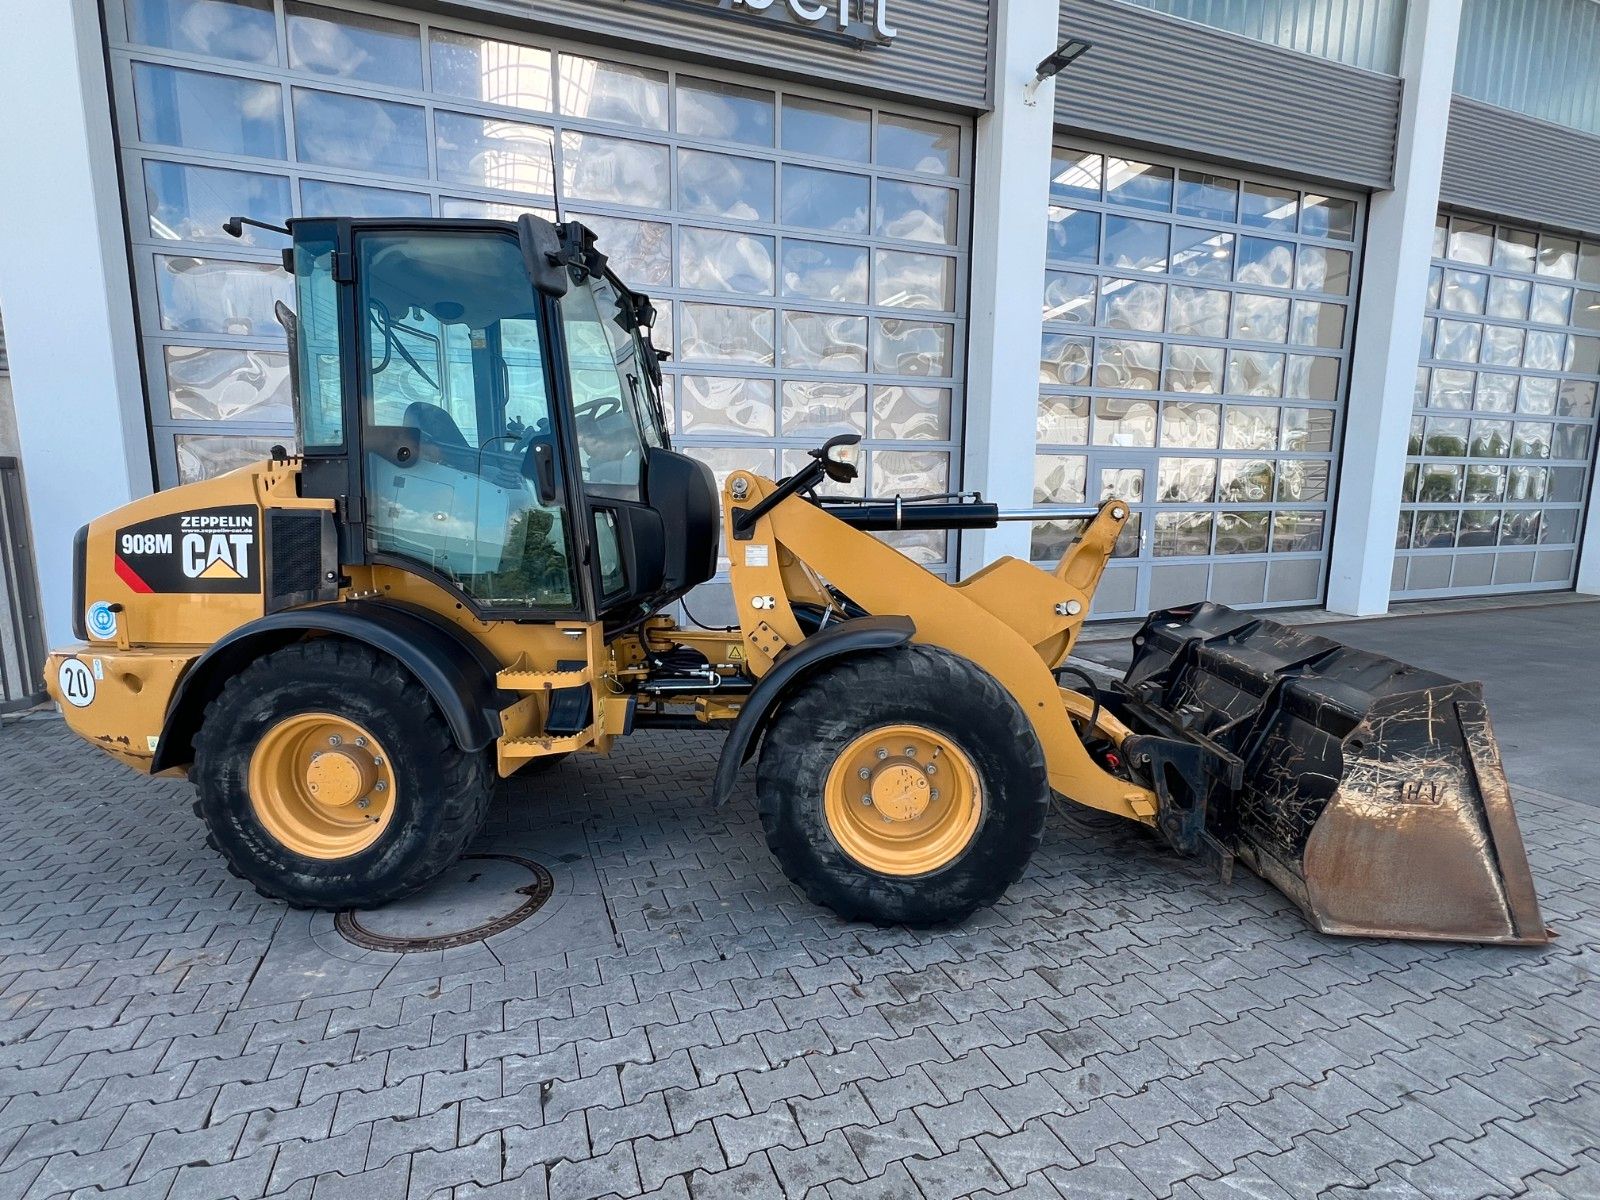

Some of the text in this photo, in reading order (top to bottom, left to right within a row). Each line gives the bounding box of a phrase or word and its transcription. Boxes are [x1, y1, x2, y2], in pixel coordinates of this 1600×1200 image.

[181, 516, 253, 527] ZEPPELIN
[121, 533, 173, 554] 908M
[181, 533, 253, 579] CAT
[65, 667, 88, 698] 20
[1401, 780, 1447, 805] CAT
